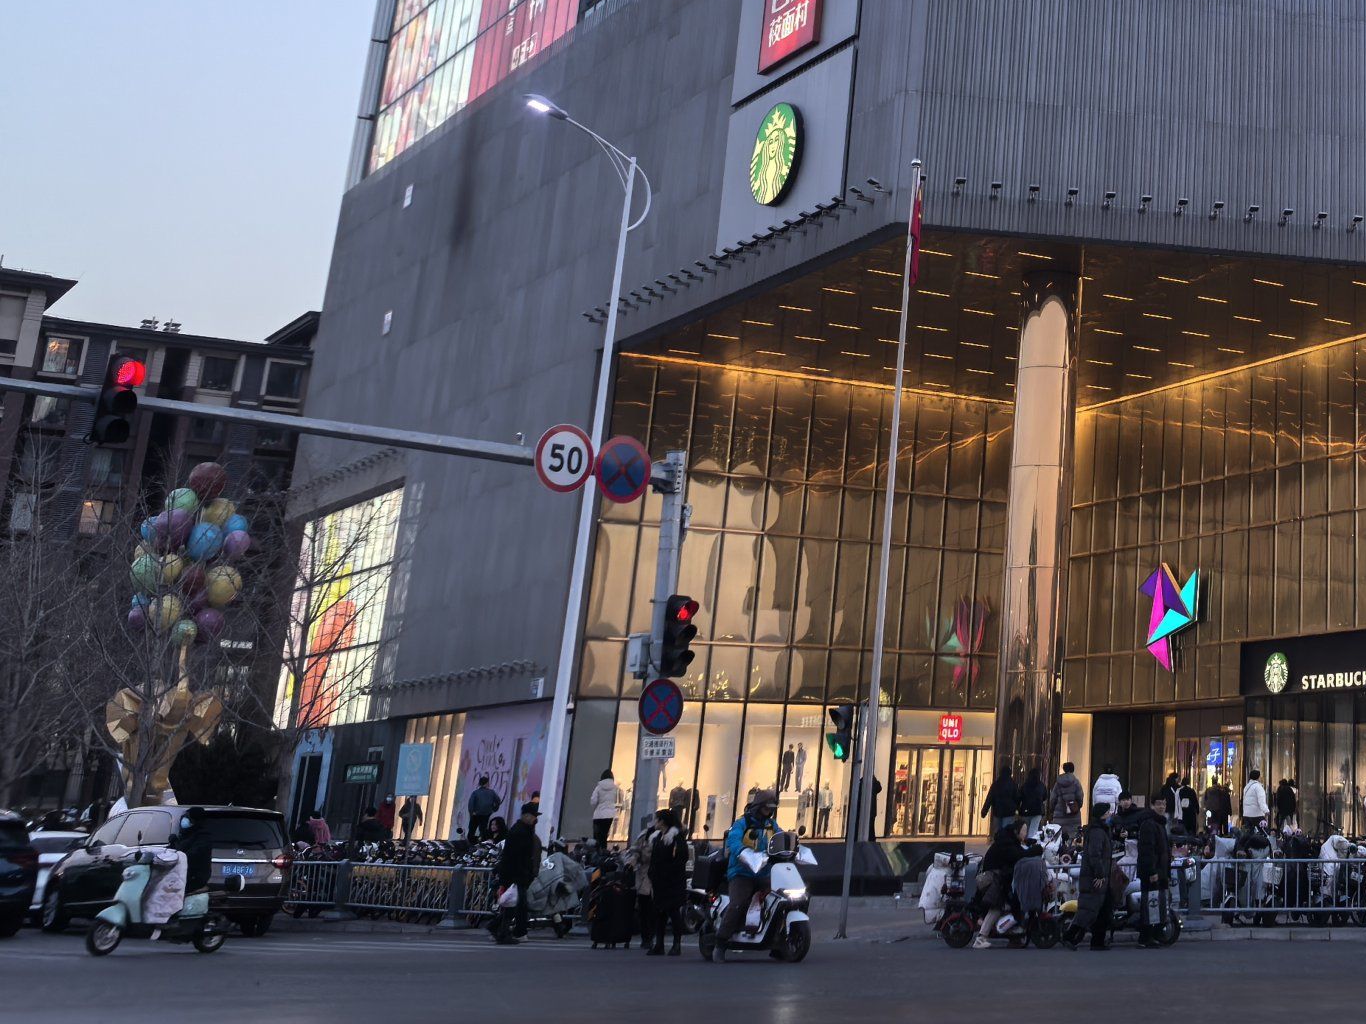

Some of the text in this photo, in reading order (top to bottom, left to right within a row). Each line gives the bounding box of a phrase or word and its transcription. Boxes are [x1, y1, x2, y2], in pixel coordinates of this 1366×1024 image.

[548, 443, 583, 475] 50
[942, 718, 959, 727] UNI
[941, 728, 959, 739] QLO
